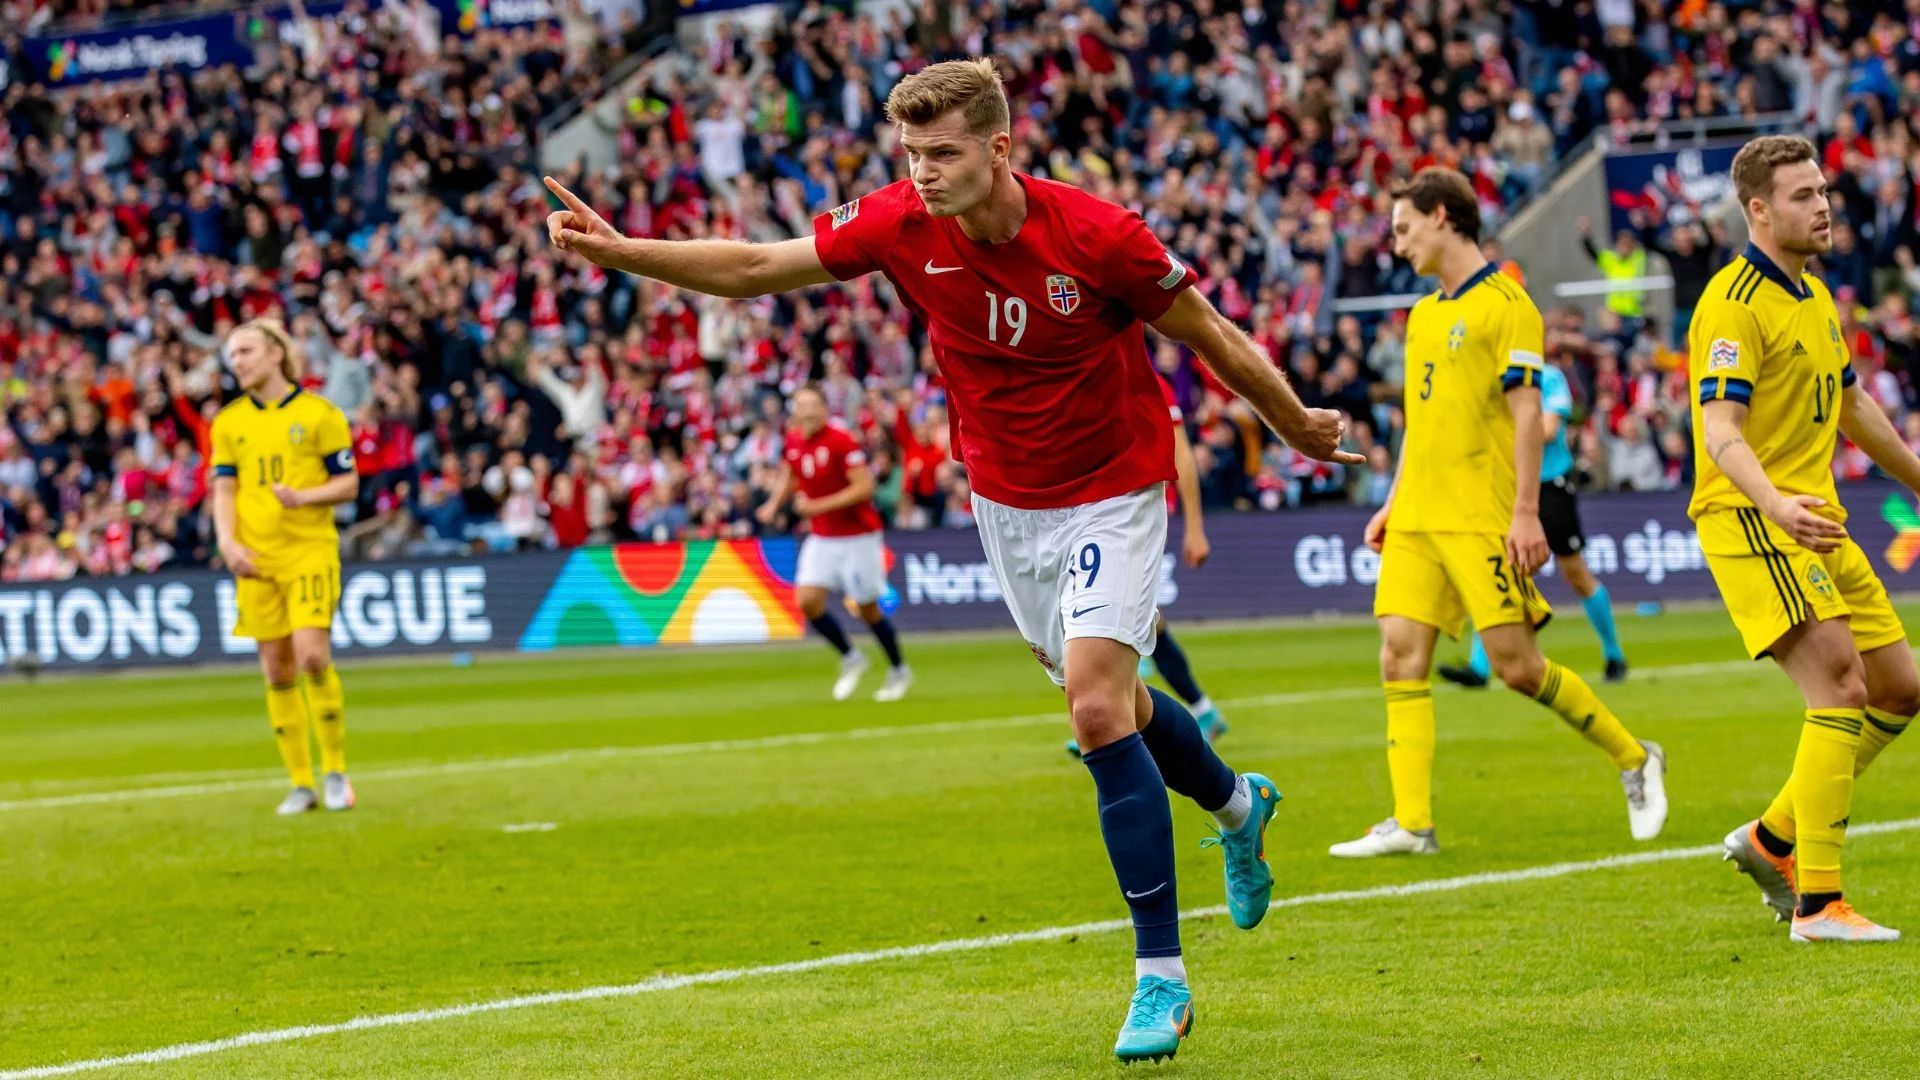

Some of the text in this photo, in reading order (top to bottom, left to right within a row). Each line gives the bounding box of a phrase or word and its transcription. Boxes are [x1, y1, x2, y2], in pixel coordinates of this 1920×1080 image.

[985, 290, 1027, 347] 19
[1420, 361, 1435, 401] 3
[257, 454, 284, 486] 10
[1293, 534, 1348, 588] Gi
[1487, 556, 1510, 594] 3
[299, 573, 326, 604] 10
[0, 565, 493, 664] TIONS LGUE
